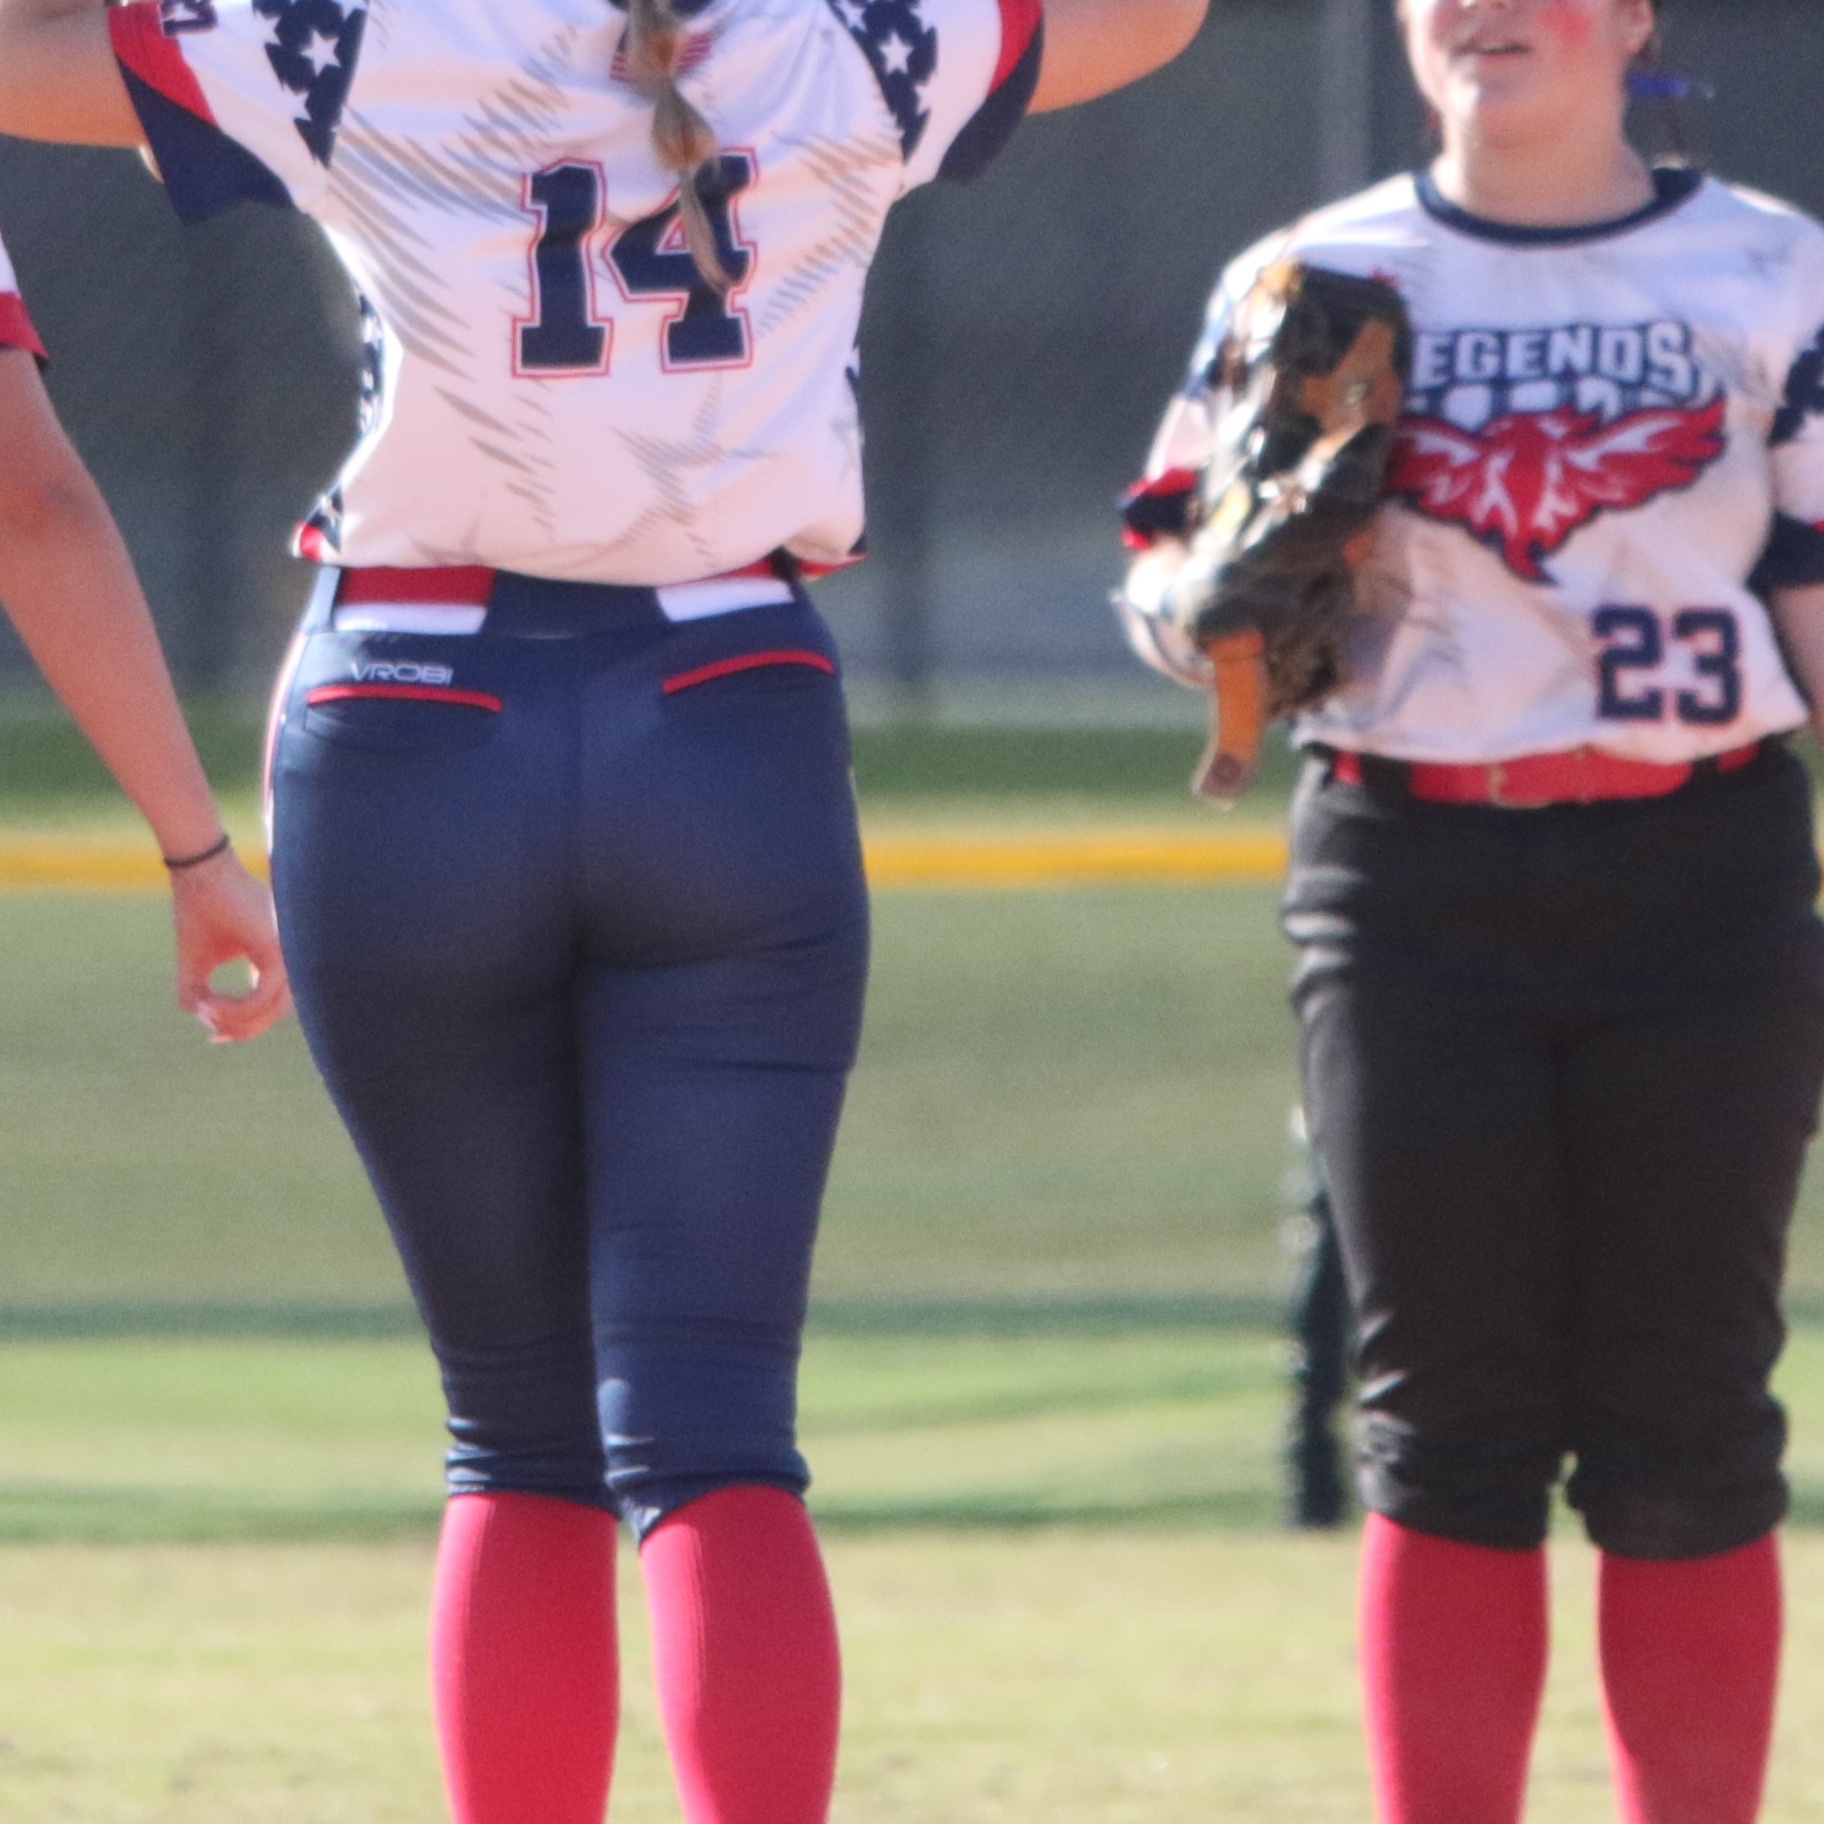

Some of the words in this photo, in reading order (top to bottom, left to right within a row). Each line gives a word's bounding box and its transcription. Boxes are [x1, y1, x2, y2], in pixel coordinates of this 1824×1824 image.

[511, 147, 759, 378] 14
[1408, 322, 1693, 397] EGENDS
[1592, 605, 1742, 724] 23
